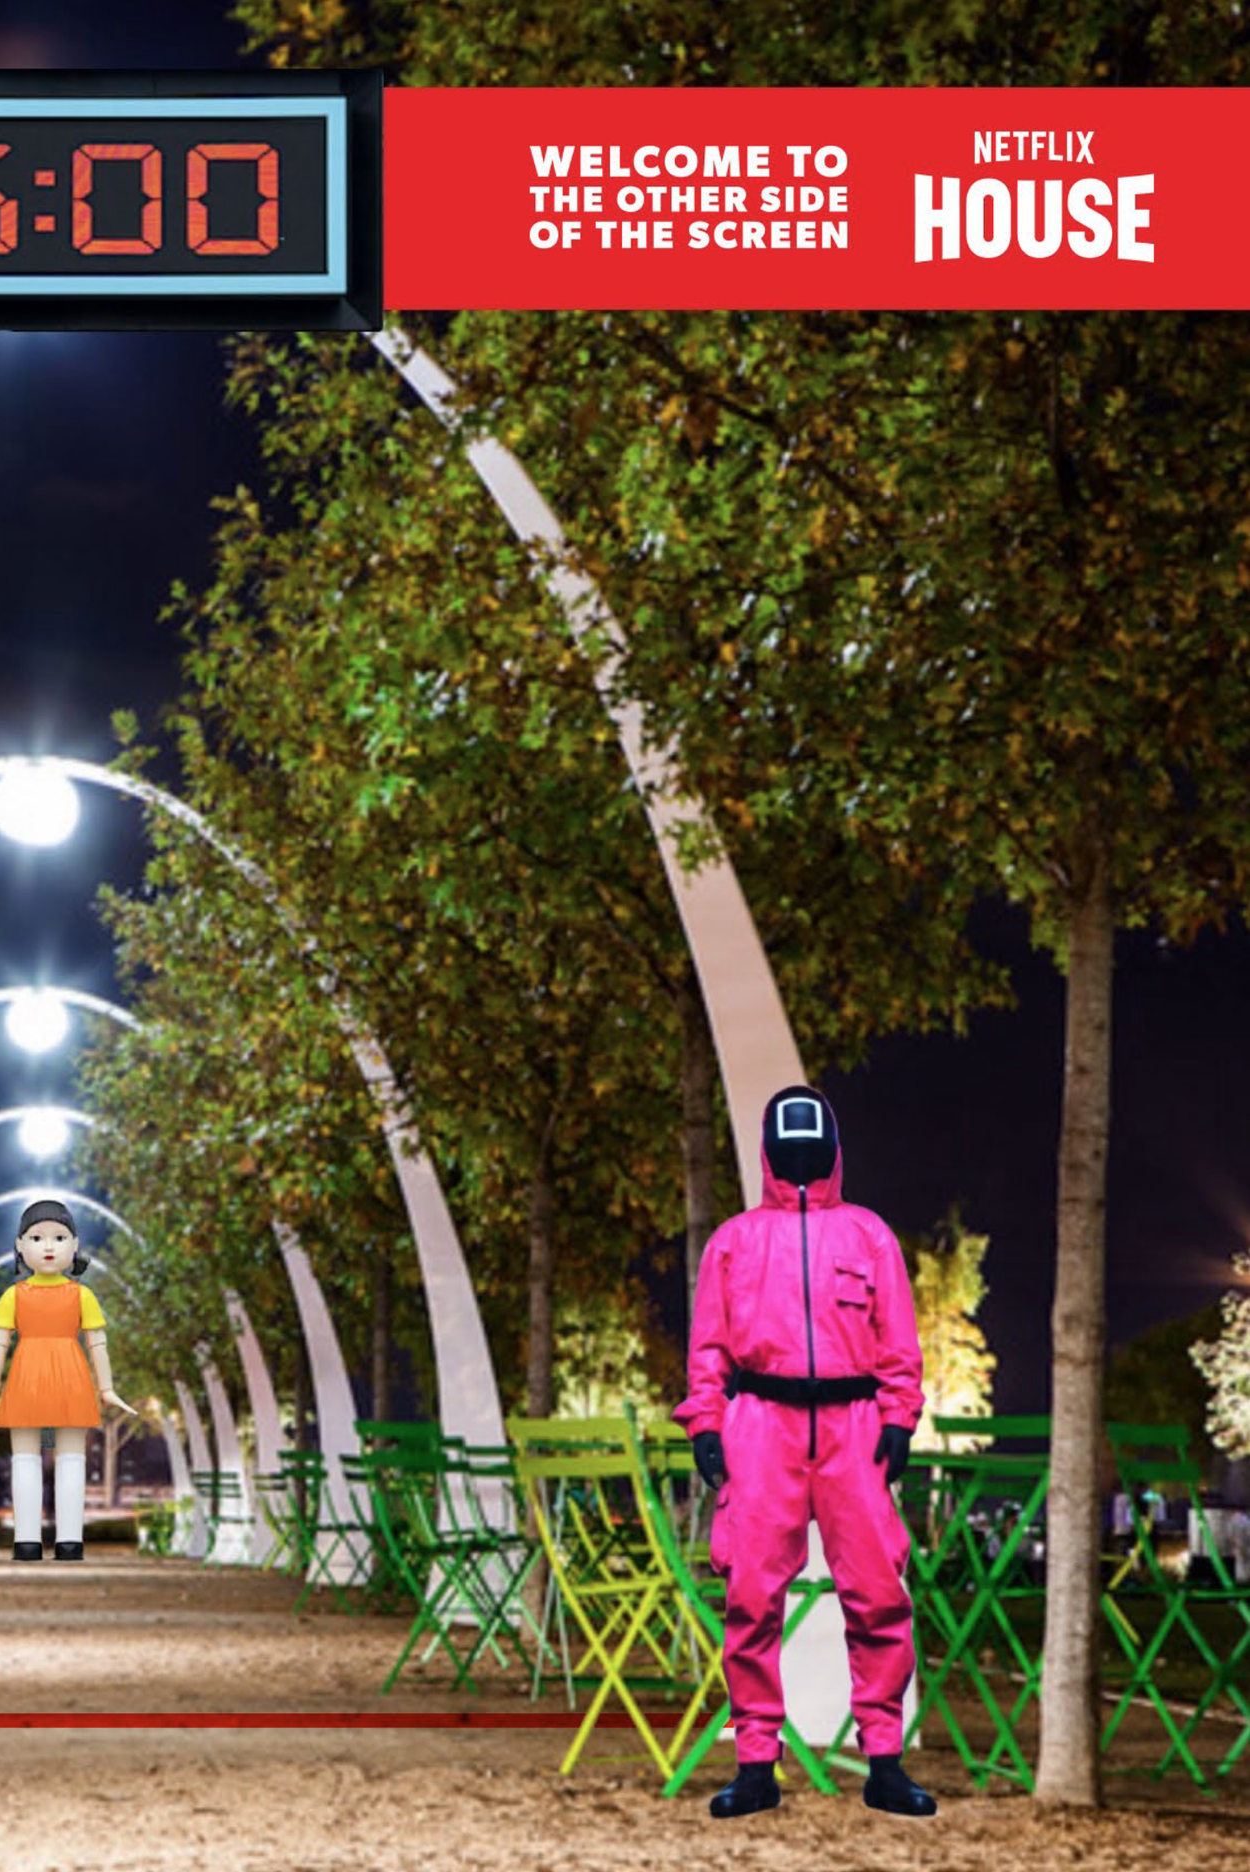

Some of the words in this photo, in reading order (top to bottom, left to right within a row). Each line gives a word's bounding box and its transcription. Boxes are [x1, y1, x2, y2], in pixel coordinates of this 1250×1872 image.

[530, 145, 770, 178] WELCOME
[786, 145, 848, 178] TO
[974, 130, 1095, 165] NETFLIX
[529, 185, 603, 213] THE
[616, 185, 748, 213] OTHER
[760, 185, 848, 213] SIDE
[529, 220, 582, 249] OF
[595, 220, 674, 249] THE
[688, 220, 848, 249] SCREEN
[914, 173, 1155, 263] HOUSE
